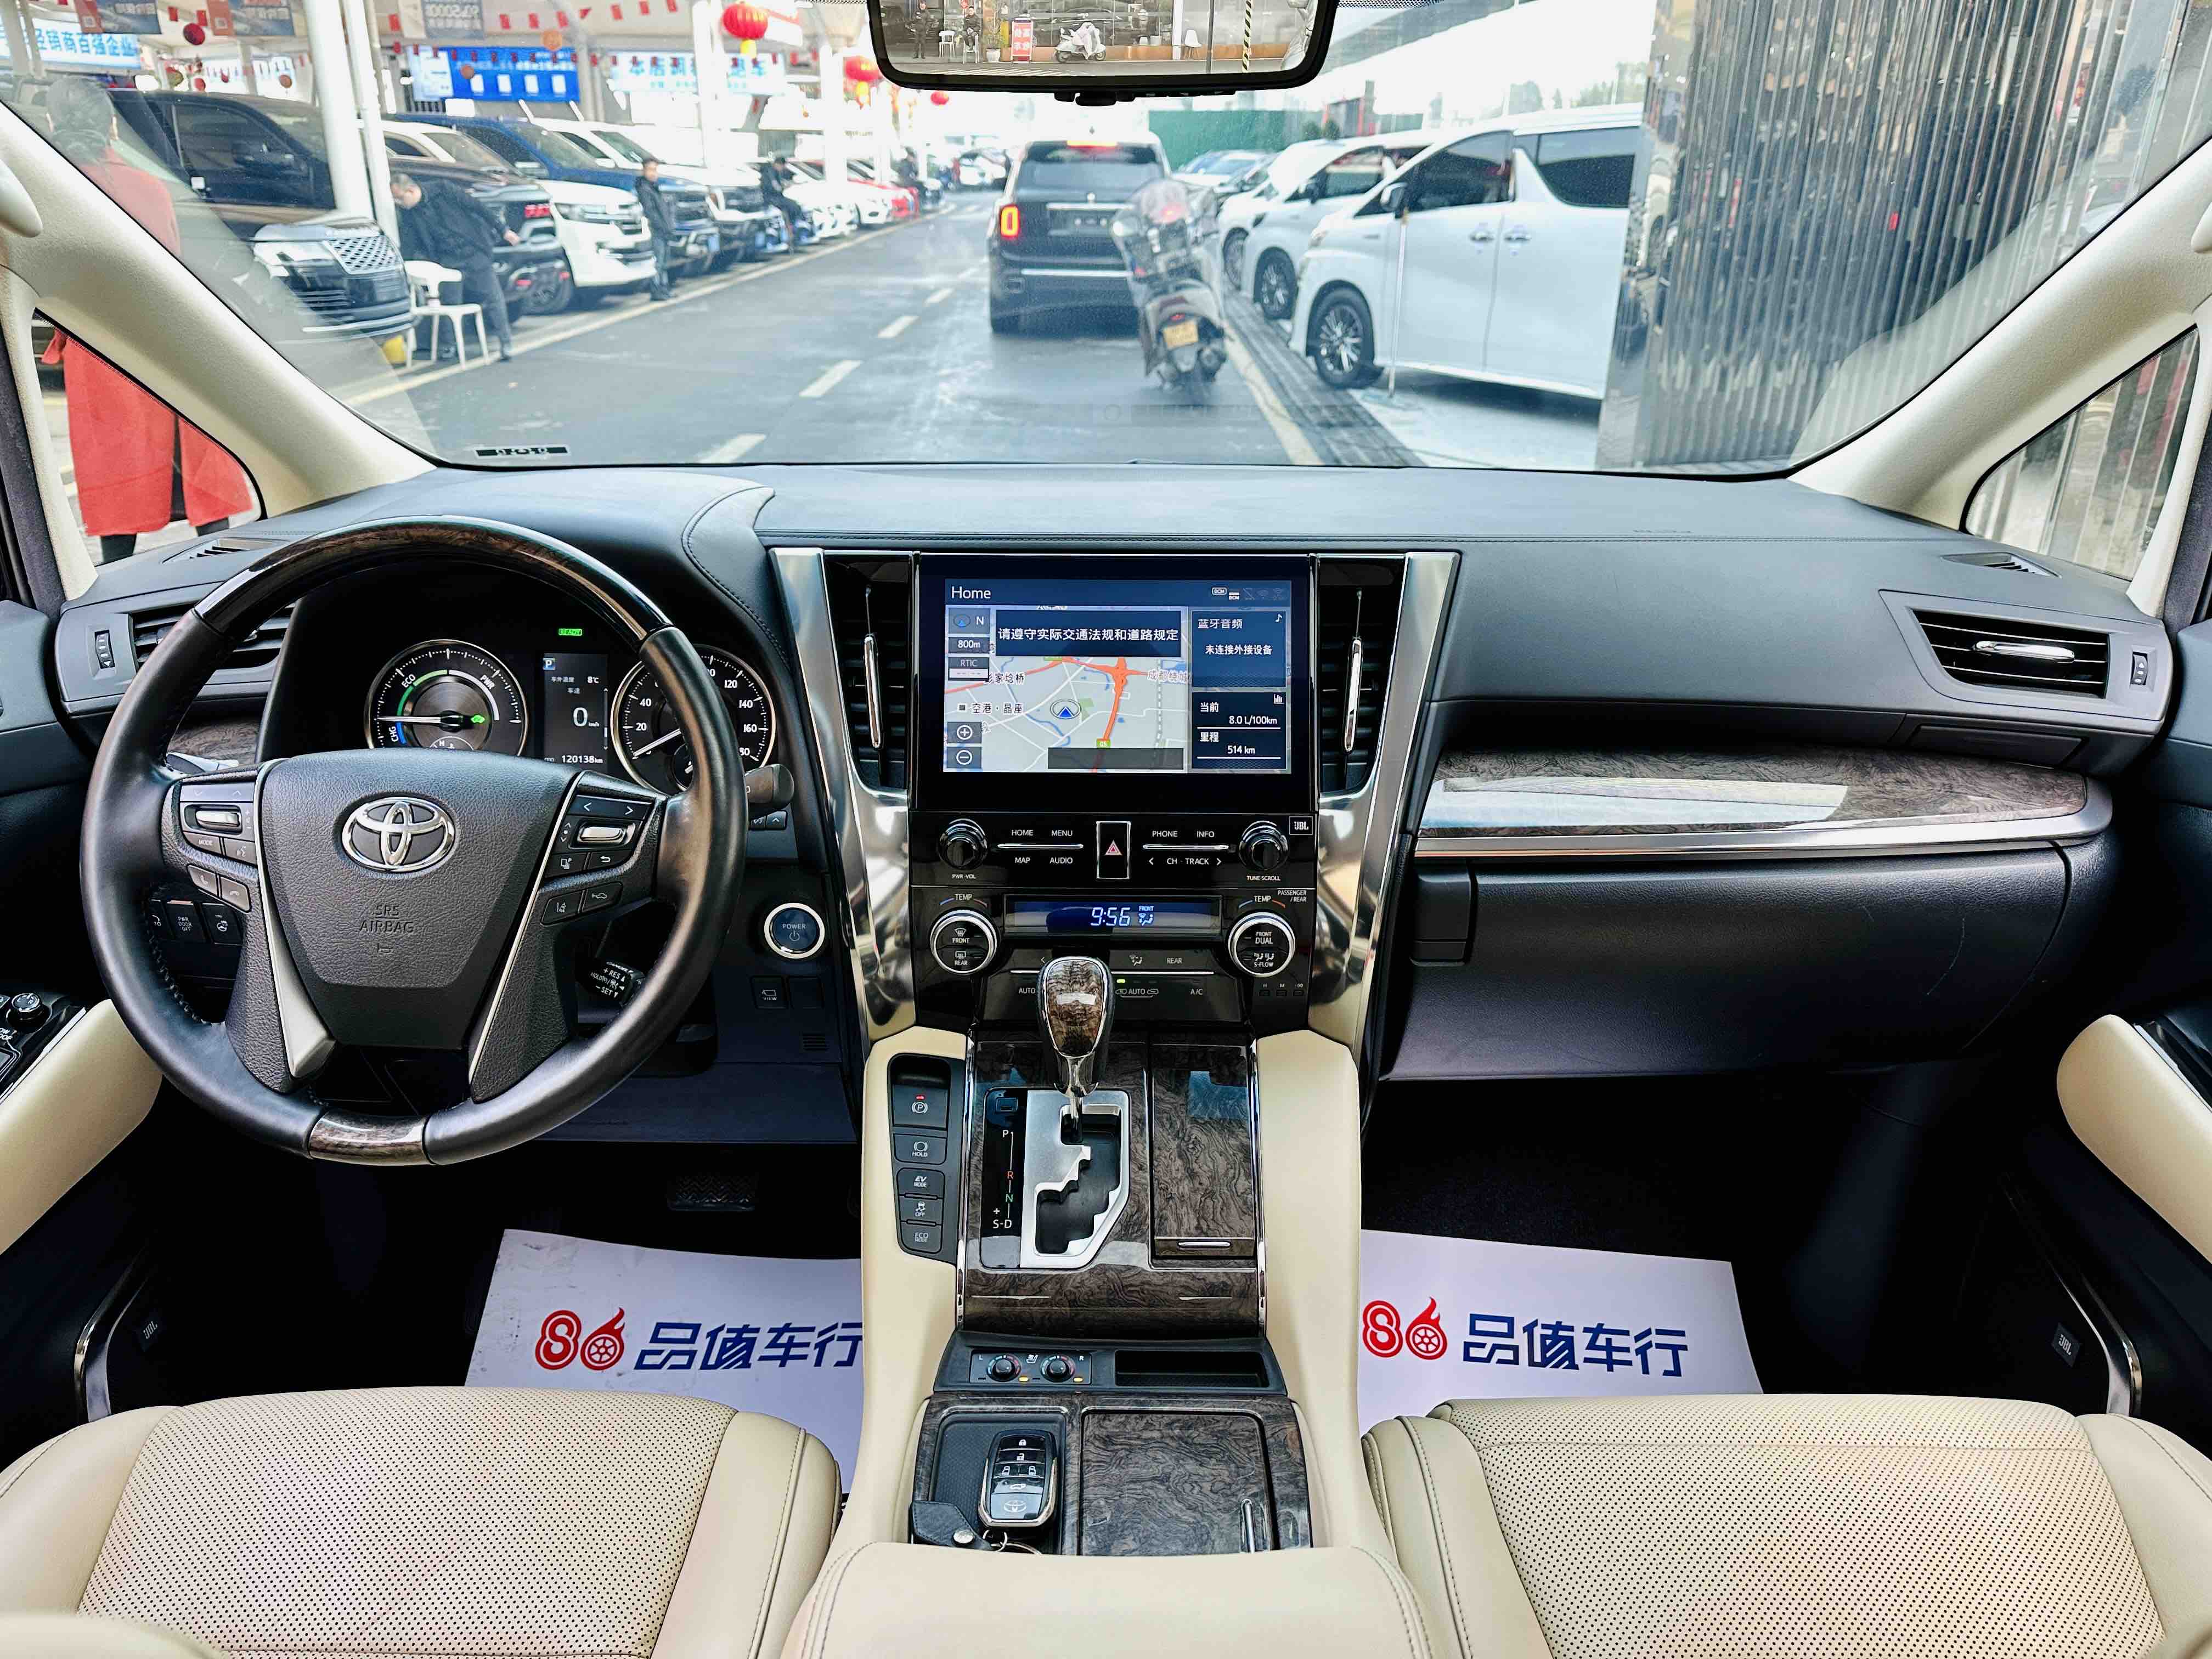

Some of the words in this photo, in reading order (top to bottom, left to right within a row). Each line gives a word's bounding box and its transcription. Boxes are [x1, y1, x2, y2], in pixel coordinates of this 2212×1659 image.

[951, 586, 991, 599] Home
[976, 616, 984, 625] N
[1198, 618, 1243, 629] 蓝牙音频
[997, 628, 1179, 641] 请遵守实际交通法规和道路规定
[958, 640, 981, 648] 800m
[1205, 644, 1273, 655] 未连接外接设备
[401, 674, 416, 688] ECO
[479, 675, 495, 690] PWR
[724, 680, 738, 689] 120
[639, 698, 652, 707] 40
[739, 700, 753, 708] 140
[1200, 702, 1219, 713] 当前
[573, 707, 588, 727] 0
[1229, 715, 1243, 724] 8.0
[1244, 715, 1278, 725] L/100km
[635, 722, 647, 731] 20
[743, 724, 757, 733] 160
[388, 726, 398, 742] CHG
[1200, 731, 1219, 742] 里程
[739, 747, 750, 756] 80
[1227, 745, 1242, 754] 514
[1244, 746, 1256, 754] km
[373, 905, 399, 916] SRS
[1090, 907, 1131, 927] 9:56
[359, 920, 414, 933] AIRBAG
[608, 969, 620, 979] RES
[601, 986, 613, 995] SET
[1002, 1130, 1009, 1138] P
[1007, 1171, 1014, 1179] R
[1006, 1194, 1013, 1203] N
[143, 1321, 157, 1339] JBL
[2058, 1334, 2072, 1356] JBL
